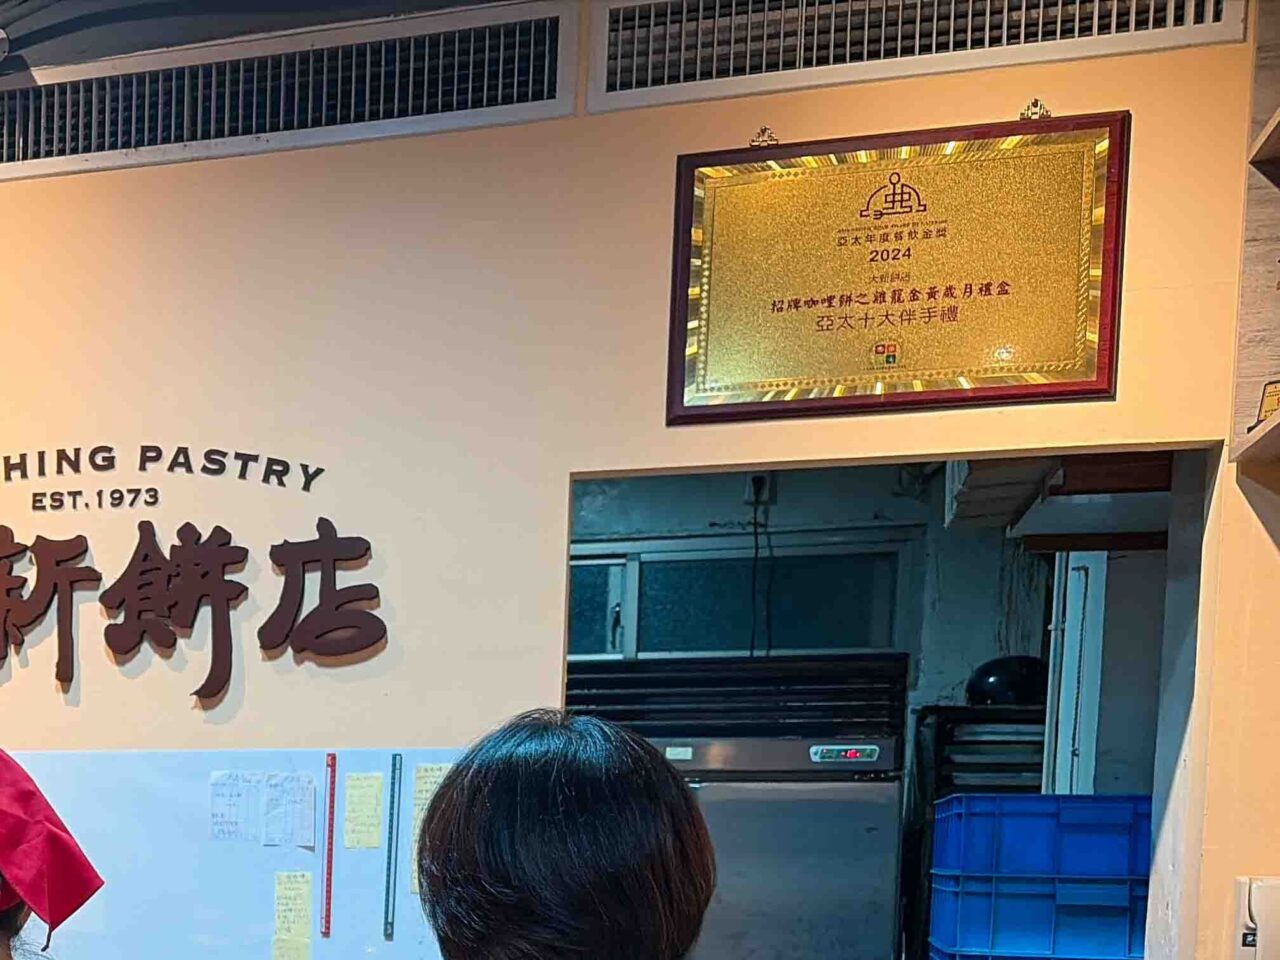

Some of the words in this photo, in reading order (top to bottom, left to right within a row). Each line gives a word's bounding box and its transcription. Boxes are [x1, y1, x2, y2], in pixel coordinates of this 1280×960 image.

[870, 247, 913, 262] 2024
[816, 305, 959, 332] 亞太十大伴手禮
[138, 445, 325, 493] PASTRY
[31, 488, 159, 511] EST.1973
